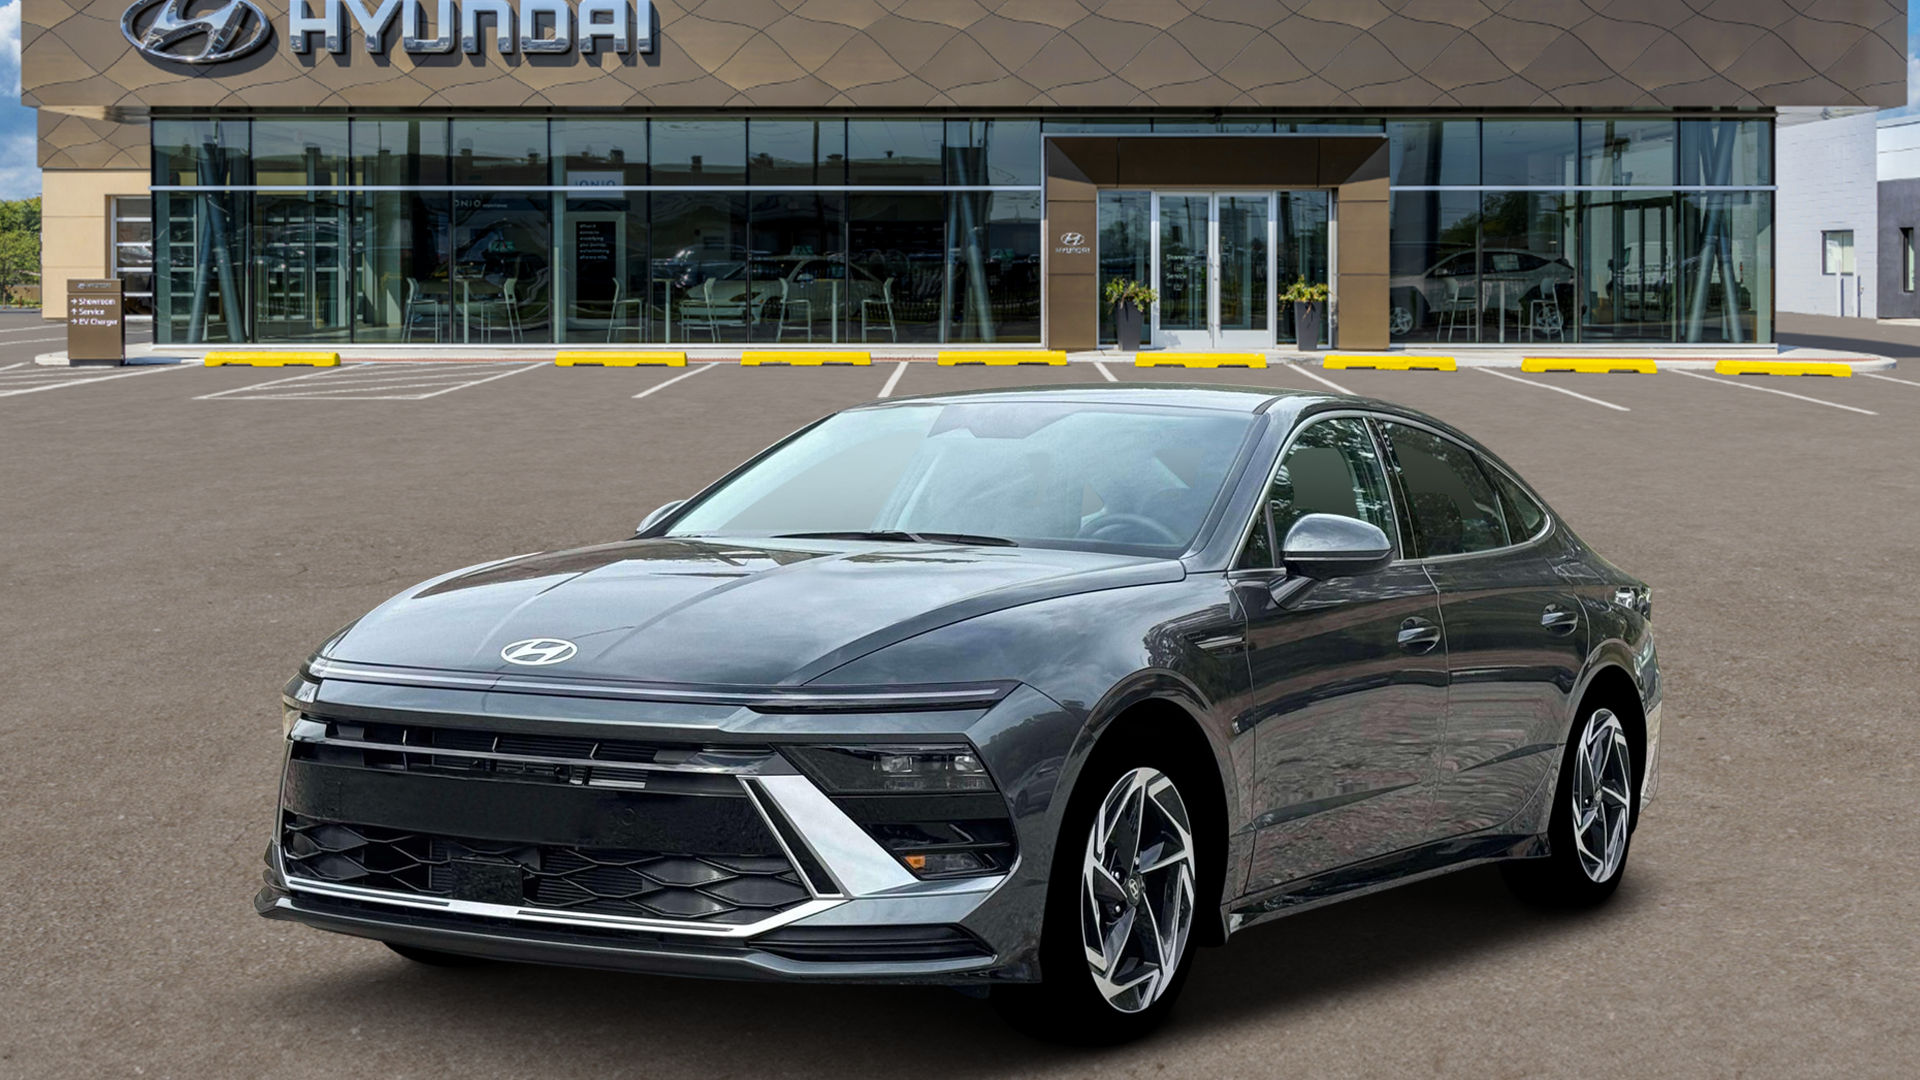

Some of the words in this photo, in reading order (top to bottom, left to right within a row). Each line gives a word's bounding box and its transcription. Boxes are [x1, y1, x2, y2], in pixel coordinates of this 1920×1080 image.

[289, 0, 653, 54] HYUNDAI
[78, 298, 116, 306] Showroom
[78, 307, 105, 316] Service
[78, 318, 90, 326] EV
[90, 318, 119, 328] Charger
